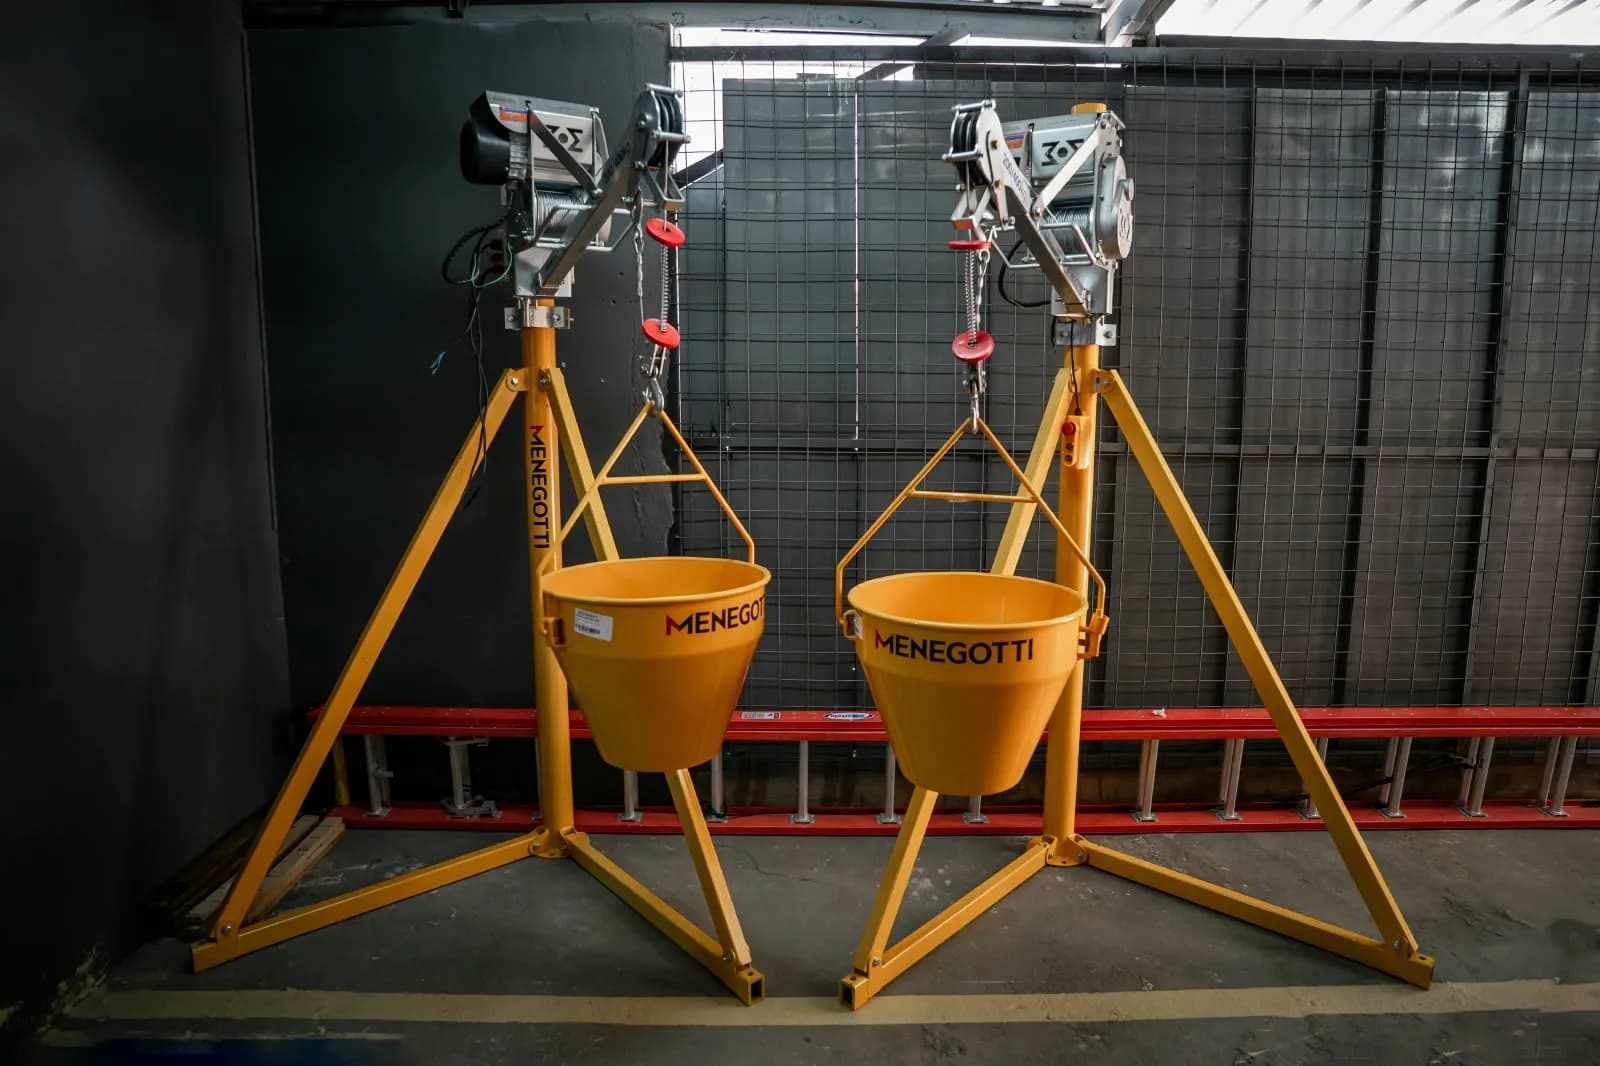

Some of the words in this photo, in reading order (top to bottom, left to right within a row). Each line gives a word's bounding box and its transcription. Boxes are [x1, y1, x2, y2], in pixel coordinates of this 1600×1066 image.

[528, 425, 550, 549] MENEGOTTI
[666, 595, 766, 637] MENEGOT
[875, 630, 1033, 664] MENEGOTTI
